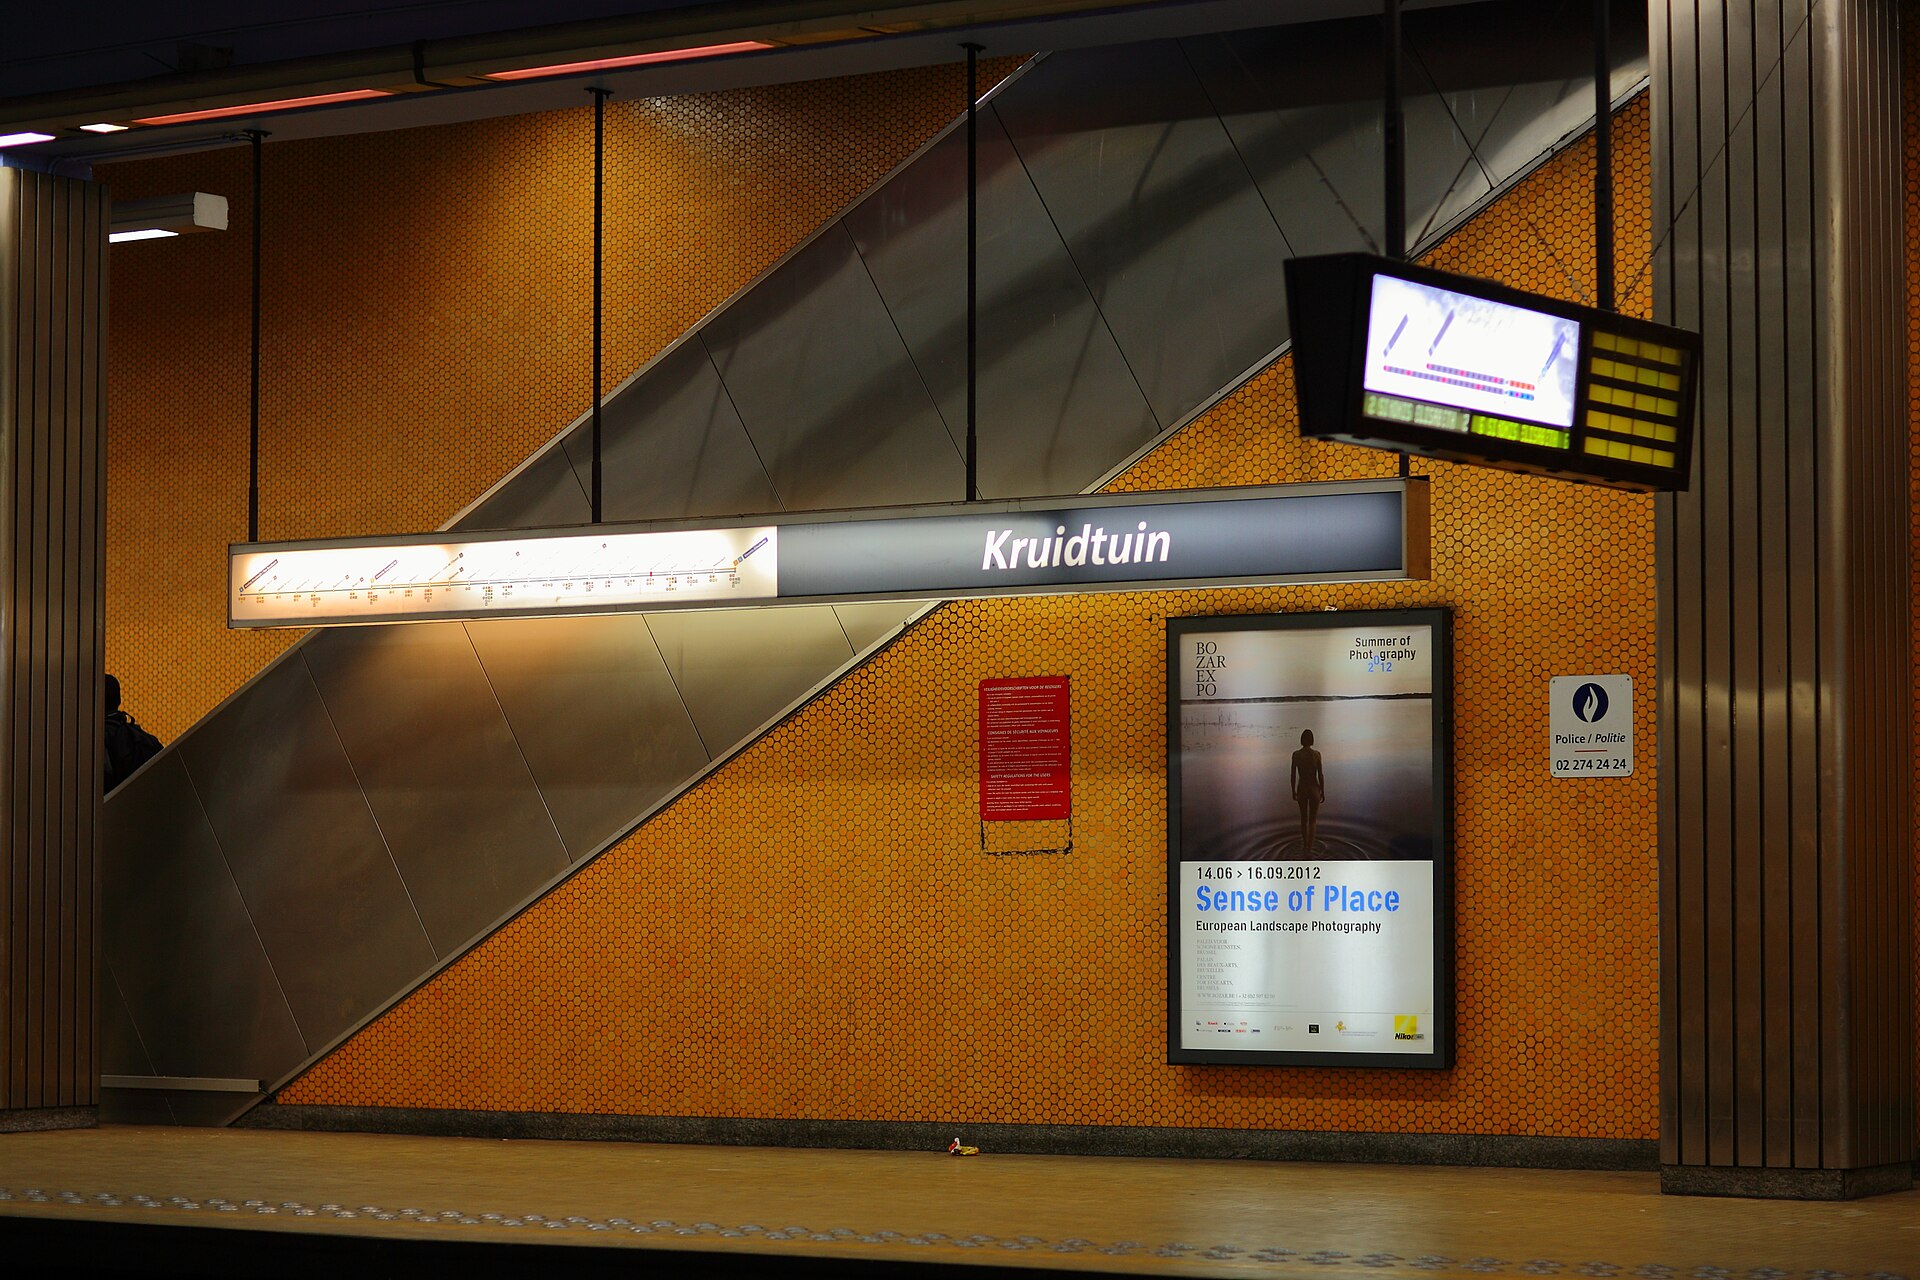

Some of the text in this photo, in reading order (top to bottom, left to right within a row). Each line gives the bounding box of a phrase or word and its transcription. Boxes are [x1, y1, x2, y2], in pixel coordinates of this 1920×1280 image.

[982, 521, 1171, 571] Kruidtuin
[1355, 635, 1411, 647] Summer of
[1196, 641, 1217, 655] BO
[1196, 655, 1227, 668] ZAR
[1196, 670, 1216, 682] EX
[1196, 683, 1217, 696] PO
[1555, 734, 1586, 744] Police
[1595, 733, 1626, 743] Politie
[1556, 759, 1627, 770] 02 274 24 24
[1197, 867, 1233, 880] 14.06
[1247, 867, 1321, 880] 16.09.2012
[1196, 885, 1400, 912] Sense of Place
[1196, 920, 1381, 934] European Landscape Photography
